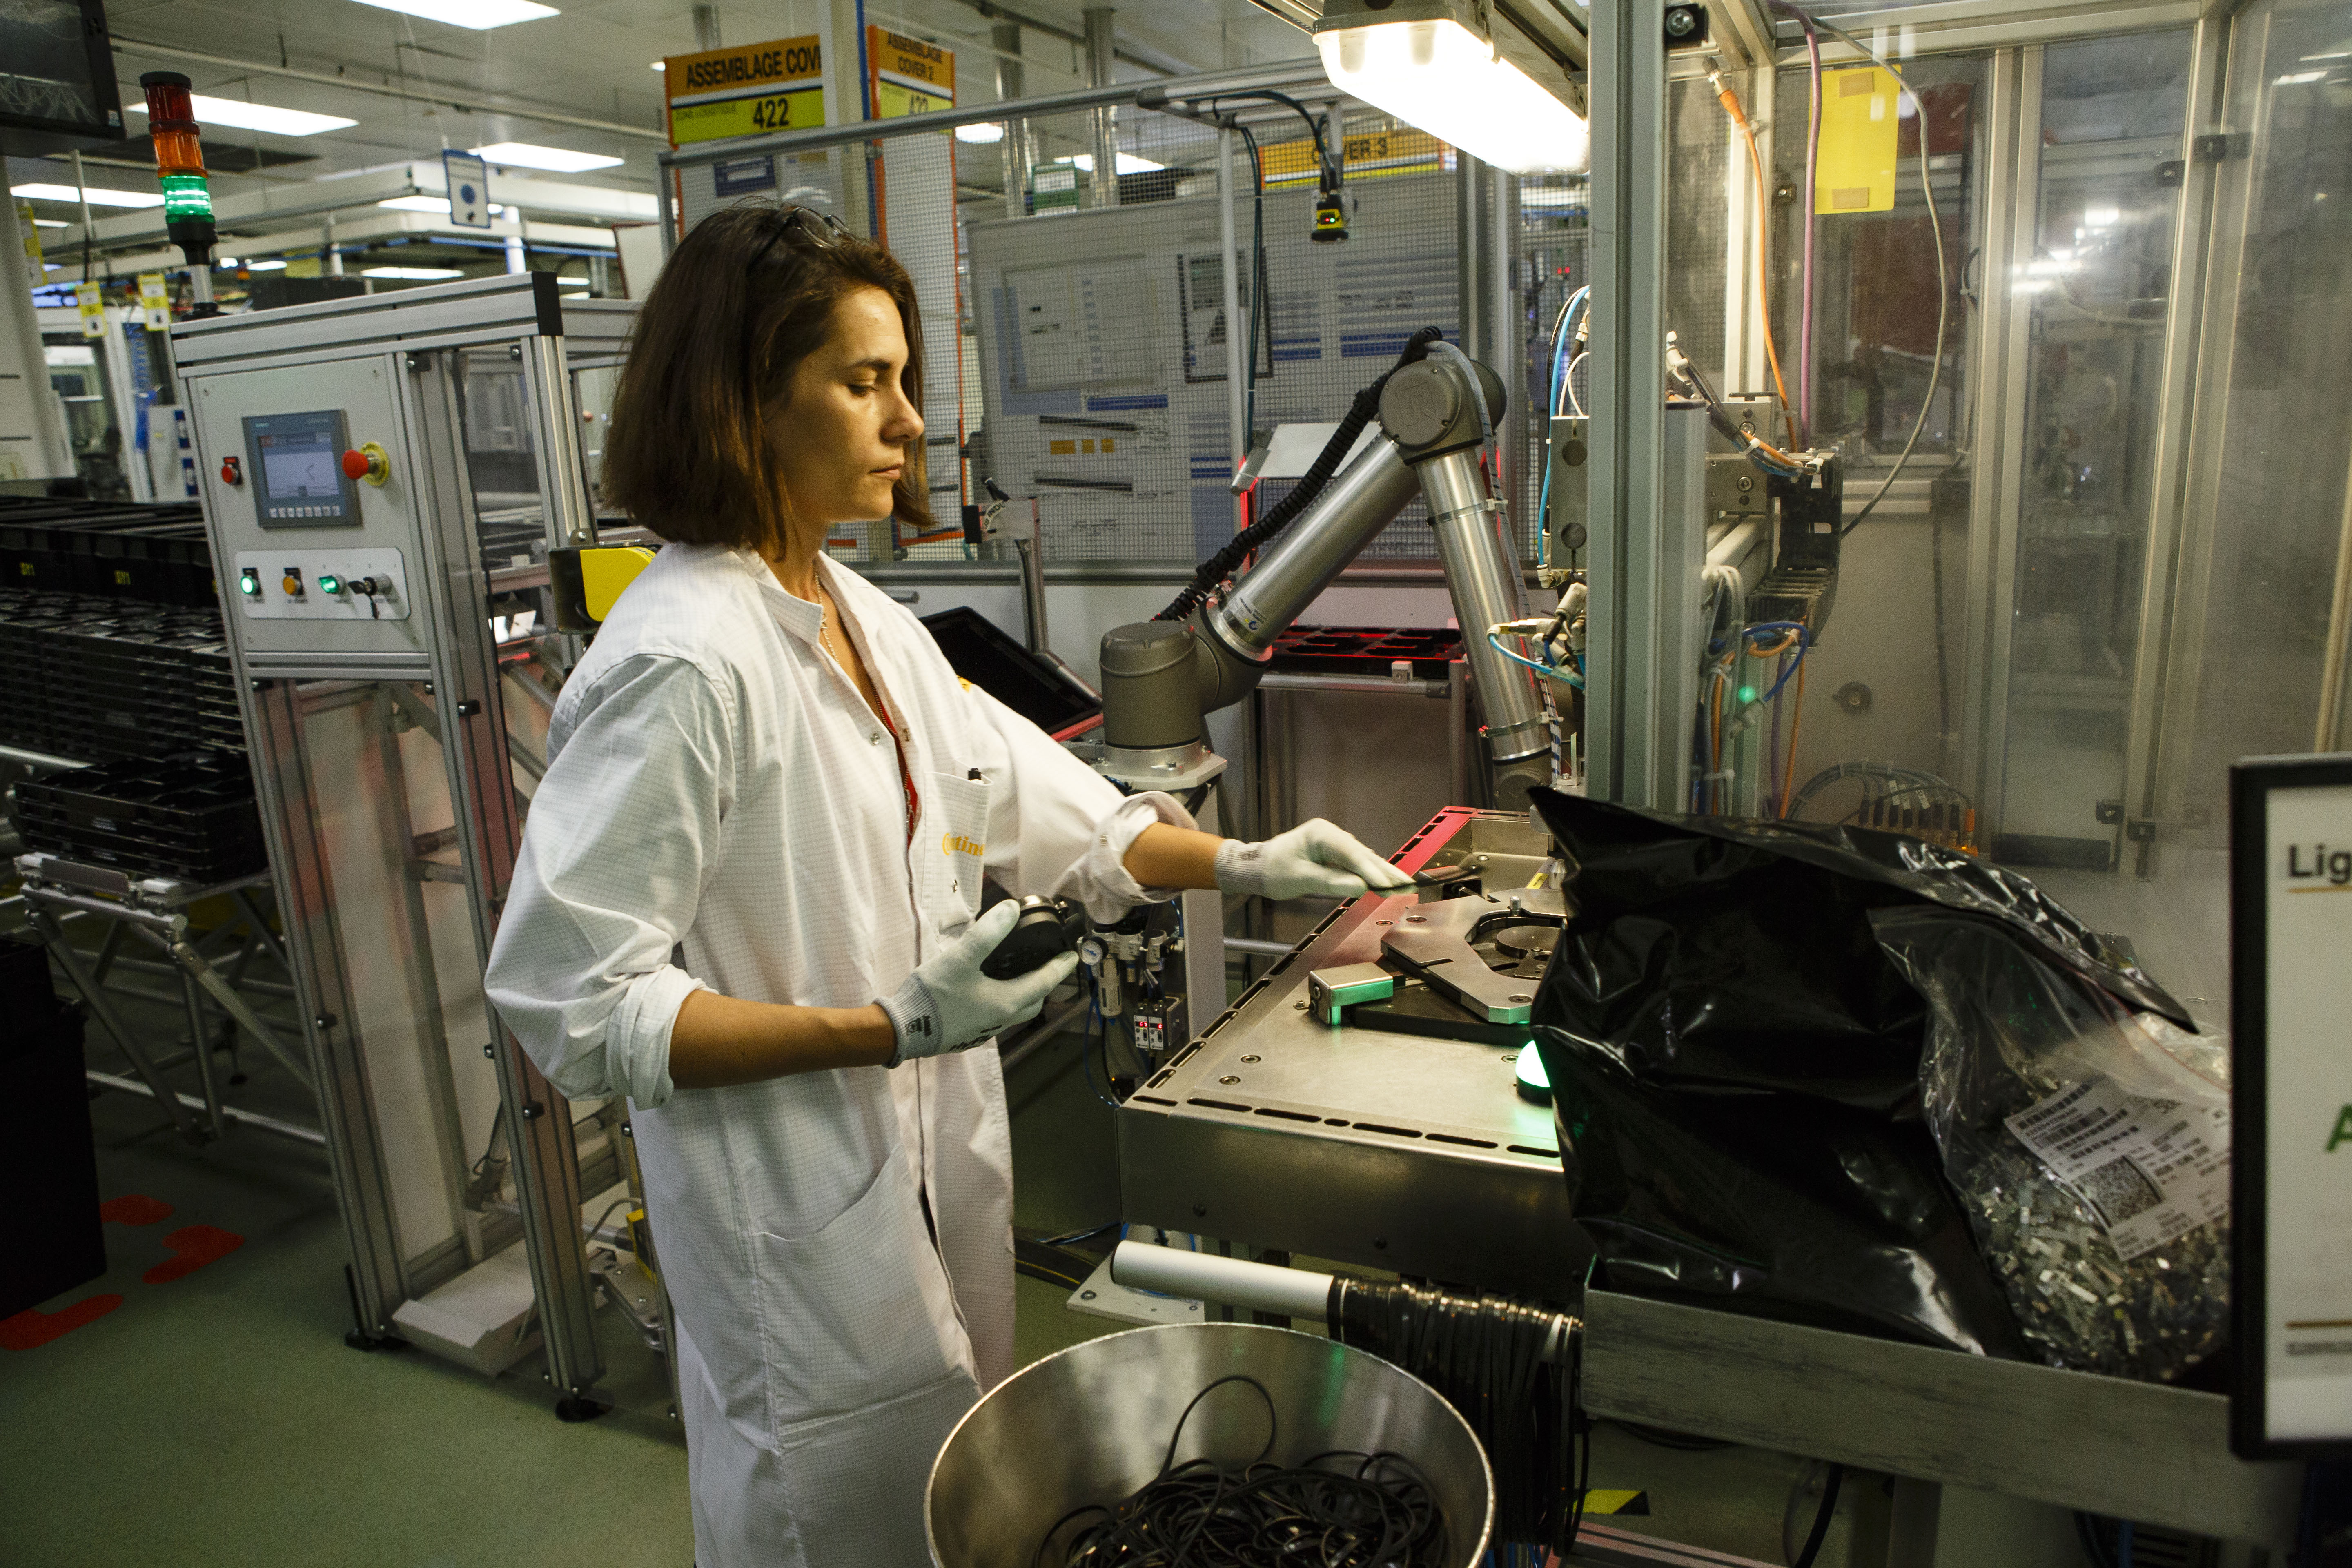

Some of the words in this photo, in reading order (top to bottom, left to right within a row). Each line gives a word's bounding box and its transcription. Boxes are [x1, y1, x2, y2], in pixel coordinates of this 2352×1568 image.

[686, 51, 782, 89] ASSEMBLAGE
[753, 97, 789, 129] 422
[1377, 137, 1387, 157] 3
[634, 548, 654, 560] SIC
[2287, 842, 2352, 885] Lig
